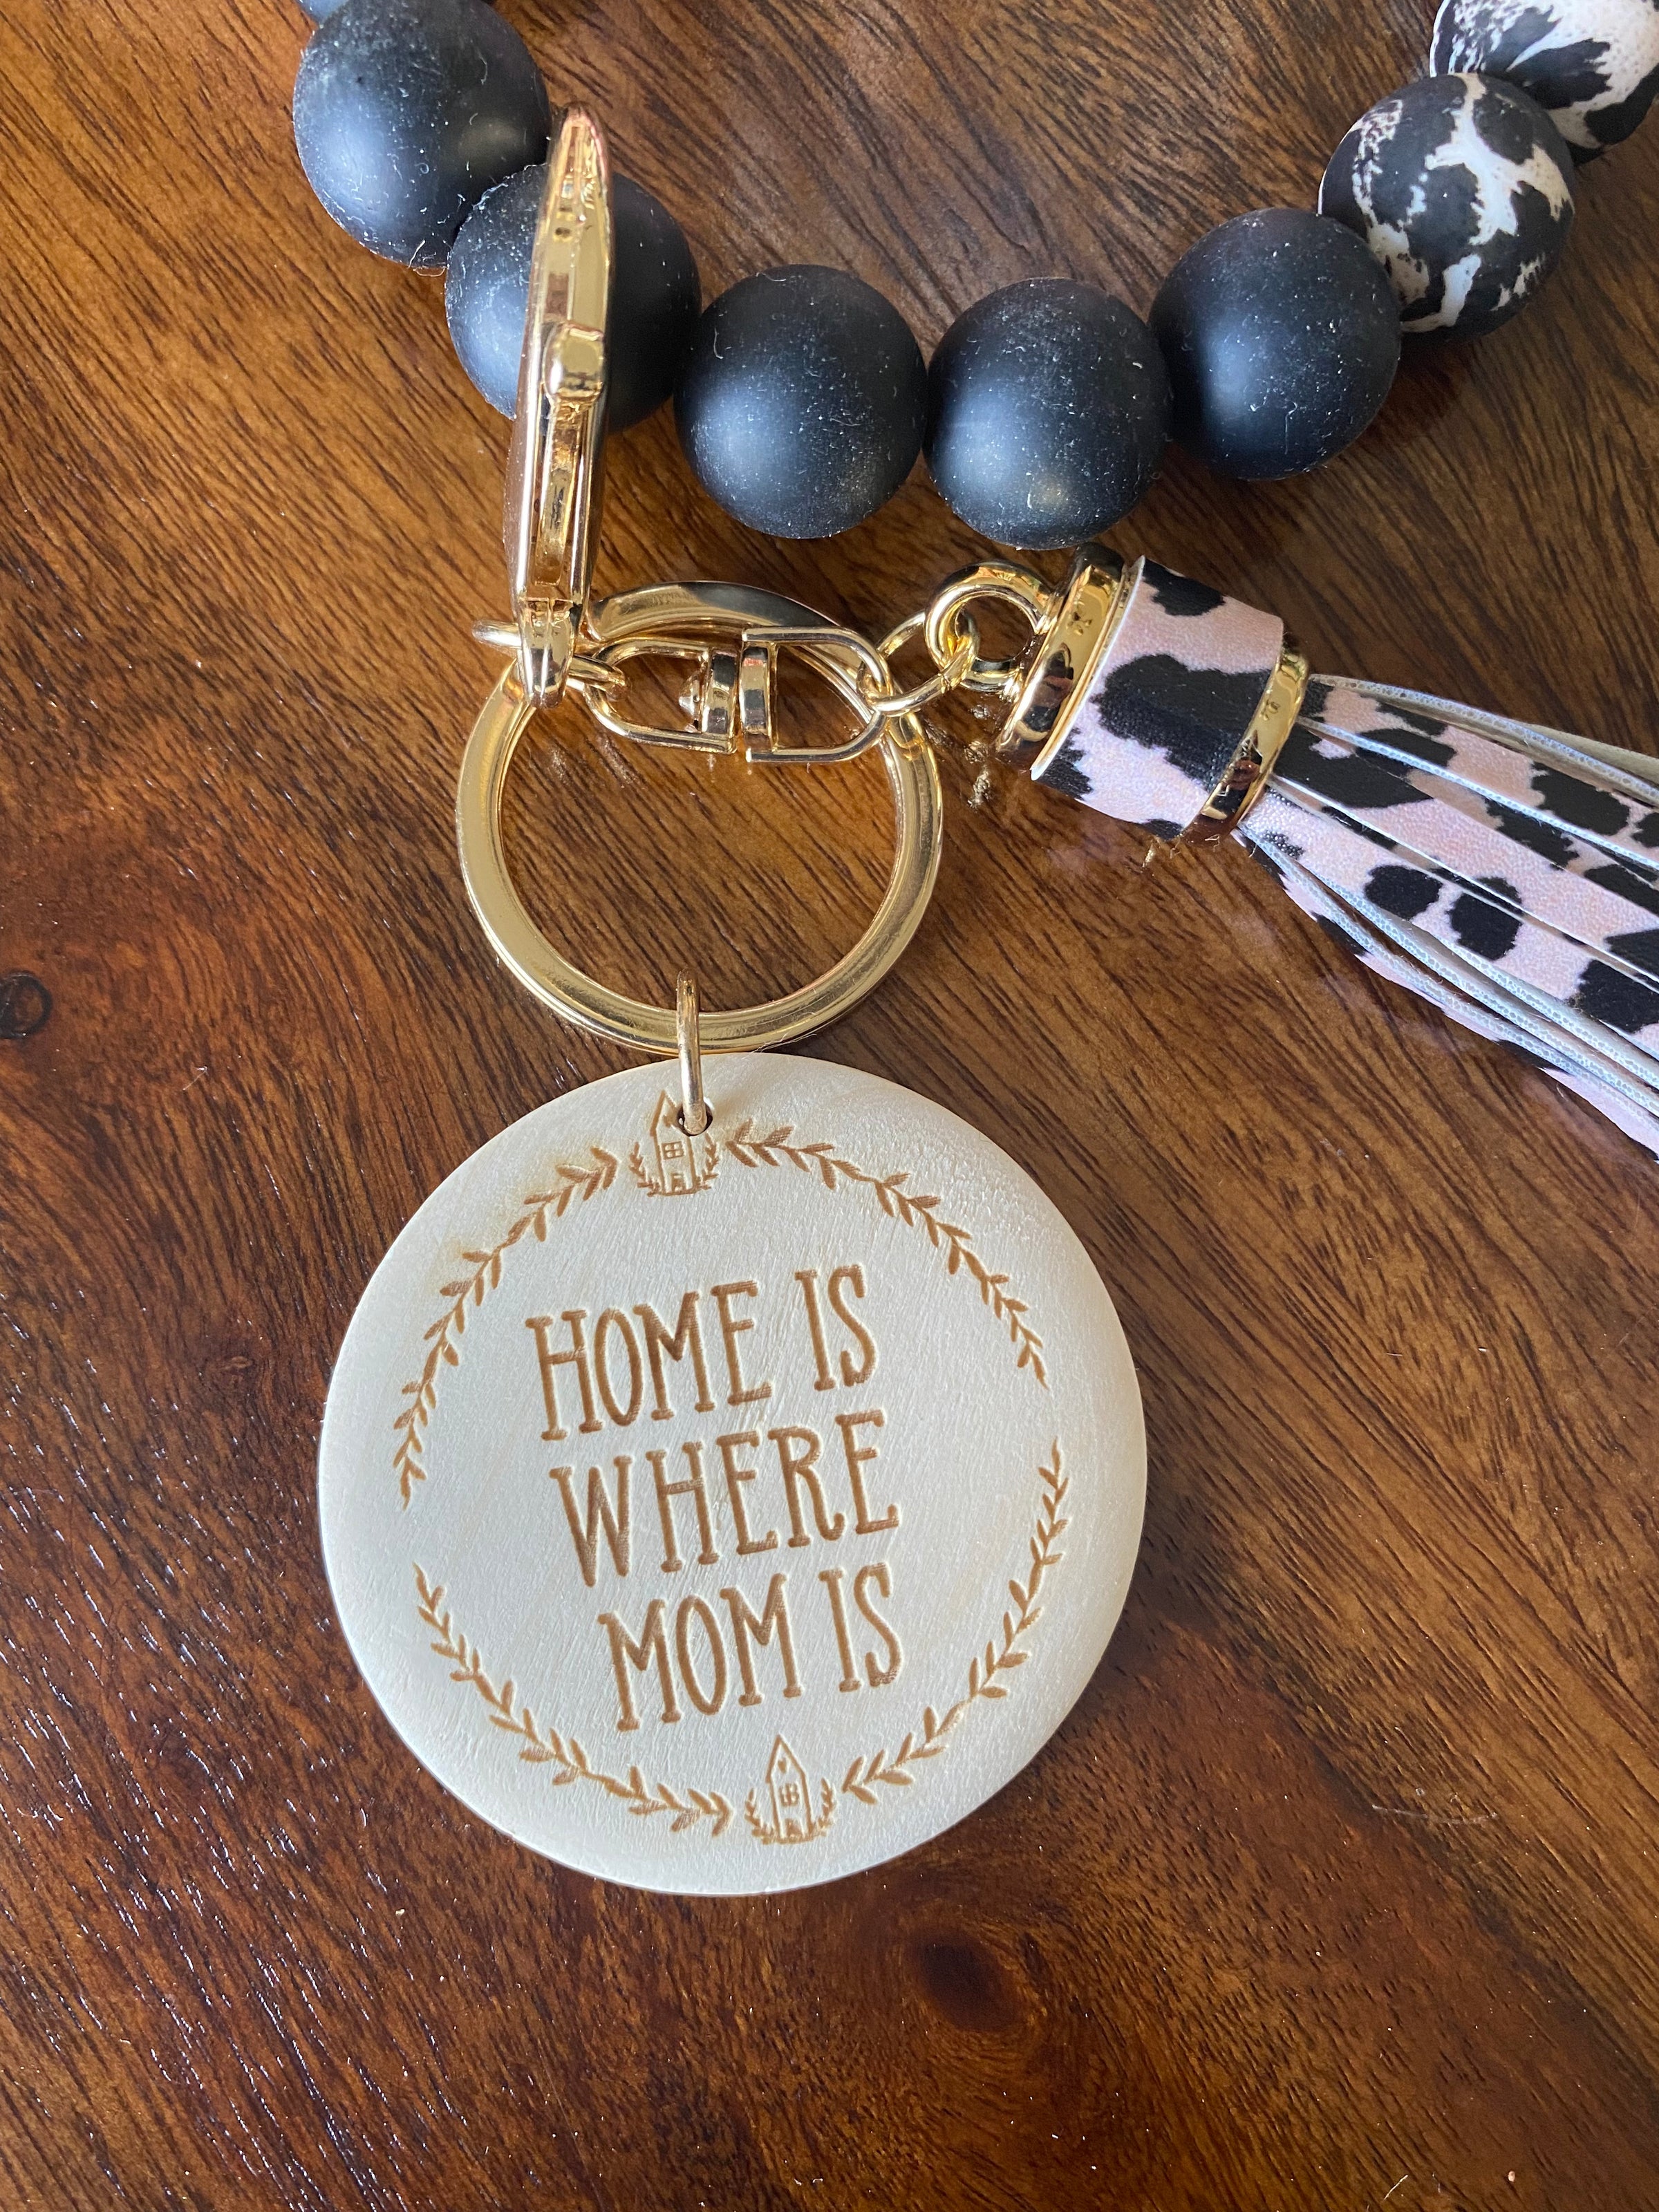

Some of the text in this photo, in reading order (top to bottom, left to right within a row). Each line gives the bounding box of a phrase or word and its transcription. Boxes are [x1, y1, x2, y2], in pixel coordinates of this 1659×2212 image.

[525, 1264, 877, 1441] HOME IS
[549, 1409, 899, 1587] WHERE
[597, 1562, 903, 1731] MOM IS
